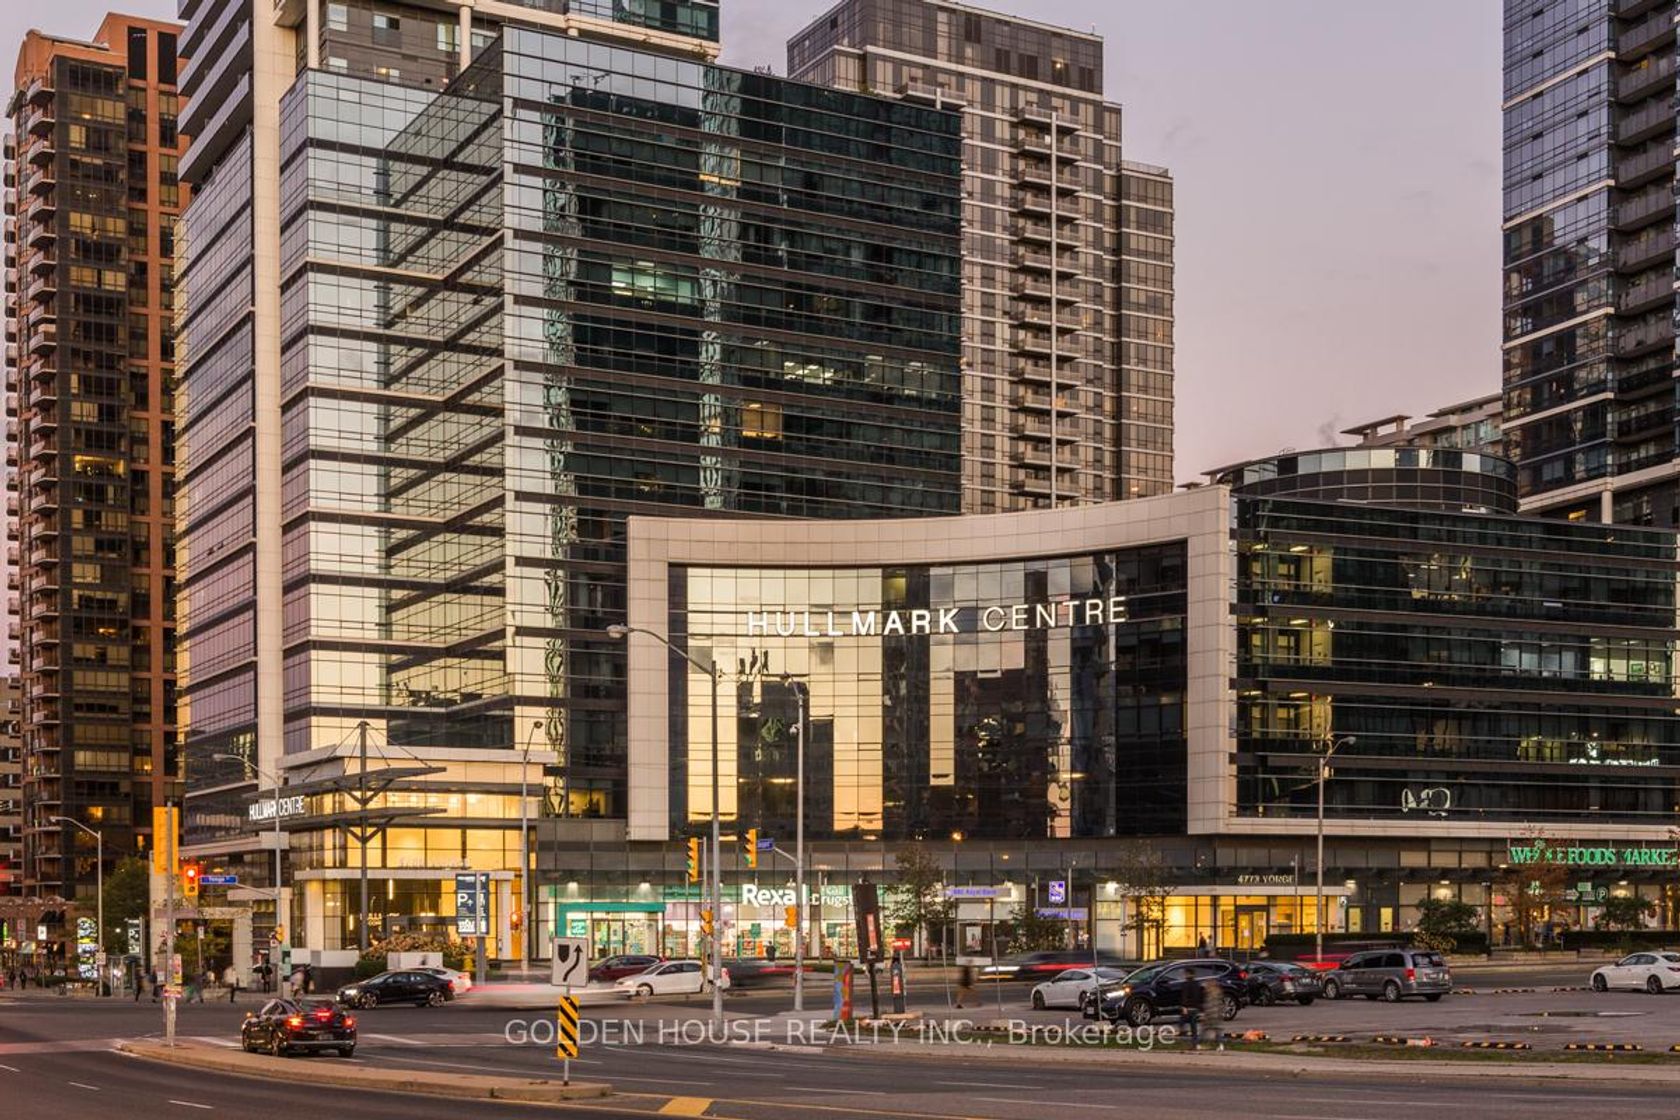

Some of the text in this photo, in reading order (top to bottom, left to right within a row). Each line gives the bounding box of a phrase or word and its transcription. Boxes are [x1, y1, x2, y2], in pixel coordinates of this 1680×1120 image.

[746, 596, 1128, 637] HULLMARK CENTRE
[248, 795, 306, 822] HULLMAR CENTRE
[1510, 846, 1567, 865] WHE
[1567, 847, 1616, 865] FOODS
[457, 893, 468, 907] P
[741, 883, 807, 907] Rexal
[811, 893, 854, 907] Drugst
